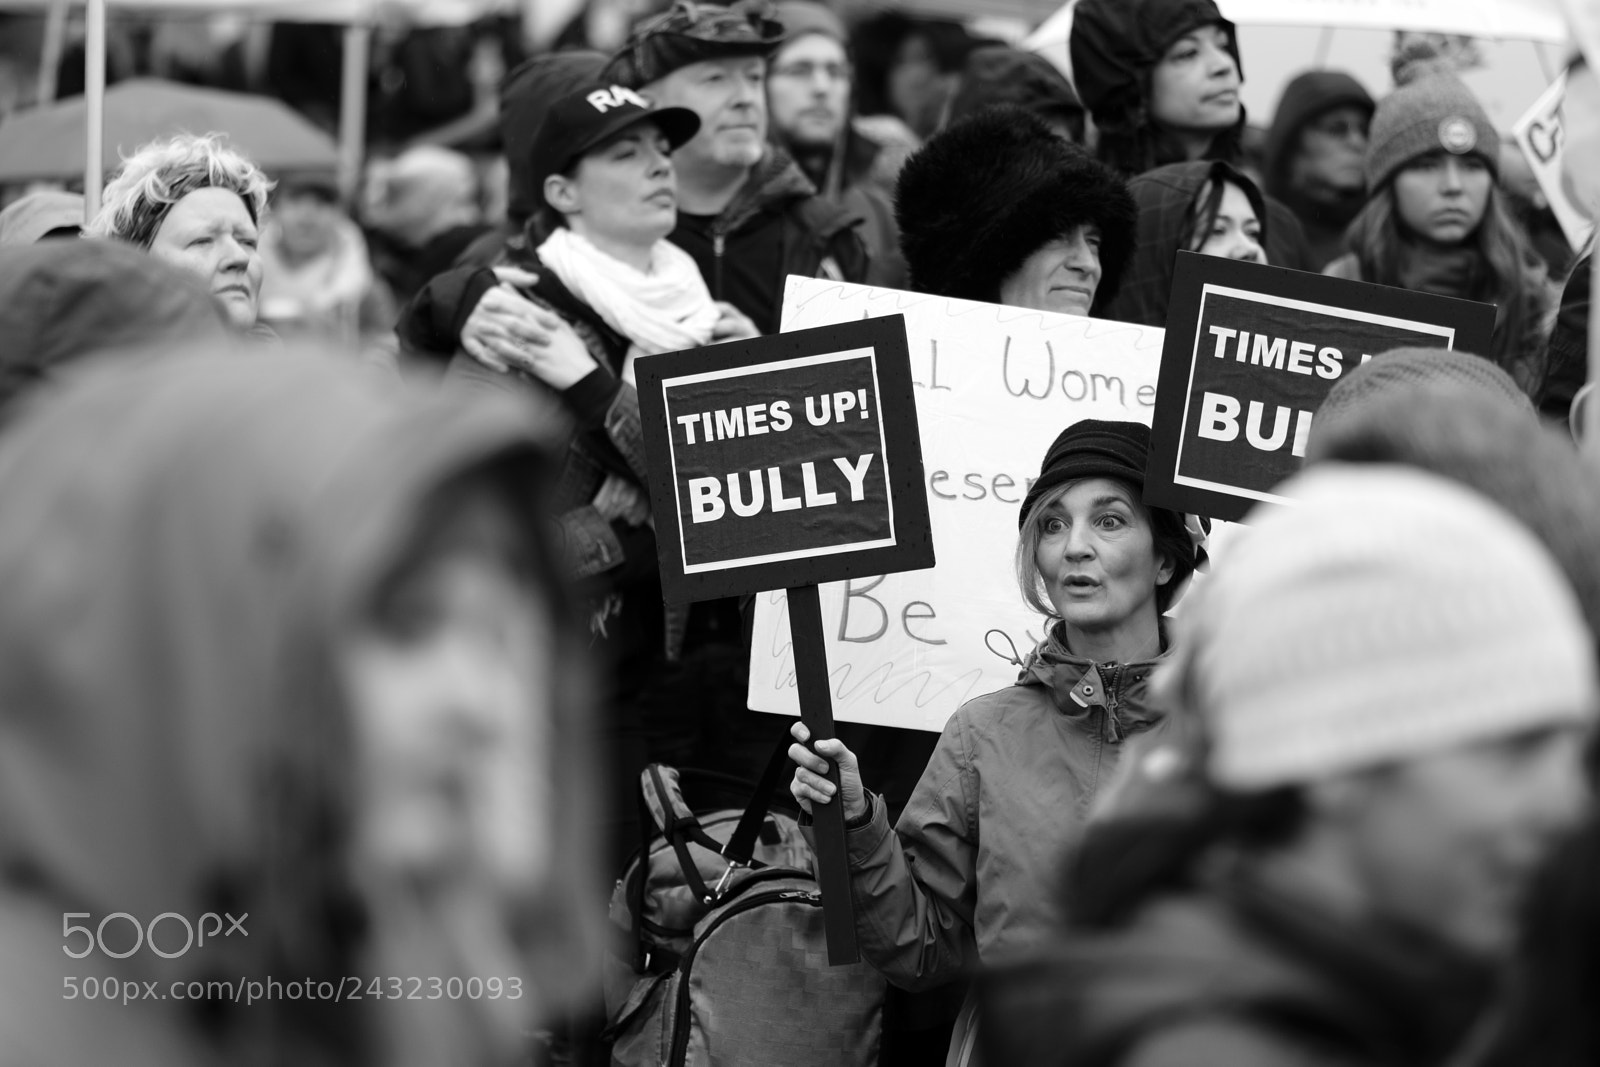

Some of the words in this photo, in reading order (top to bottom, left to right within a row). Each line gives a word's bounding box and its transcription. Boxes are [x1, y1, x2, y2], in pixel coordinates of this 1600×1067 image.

[1003, 335, 1156, 410] Wome
[1208, 325, 1344, 380] TIMES
[676, 400, 793, 445] TIMES
[804, 388, 869, 427] UP!
[688, 452, 875, 524] BULLY
[837, 574, 948, 645] Be
